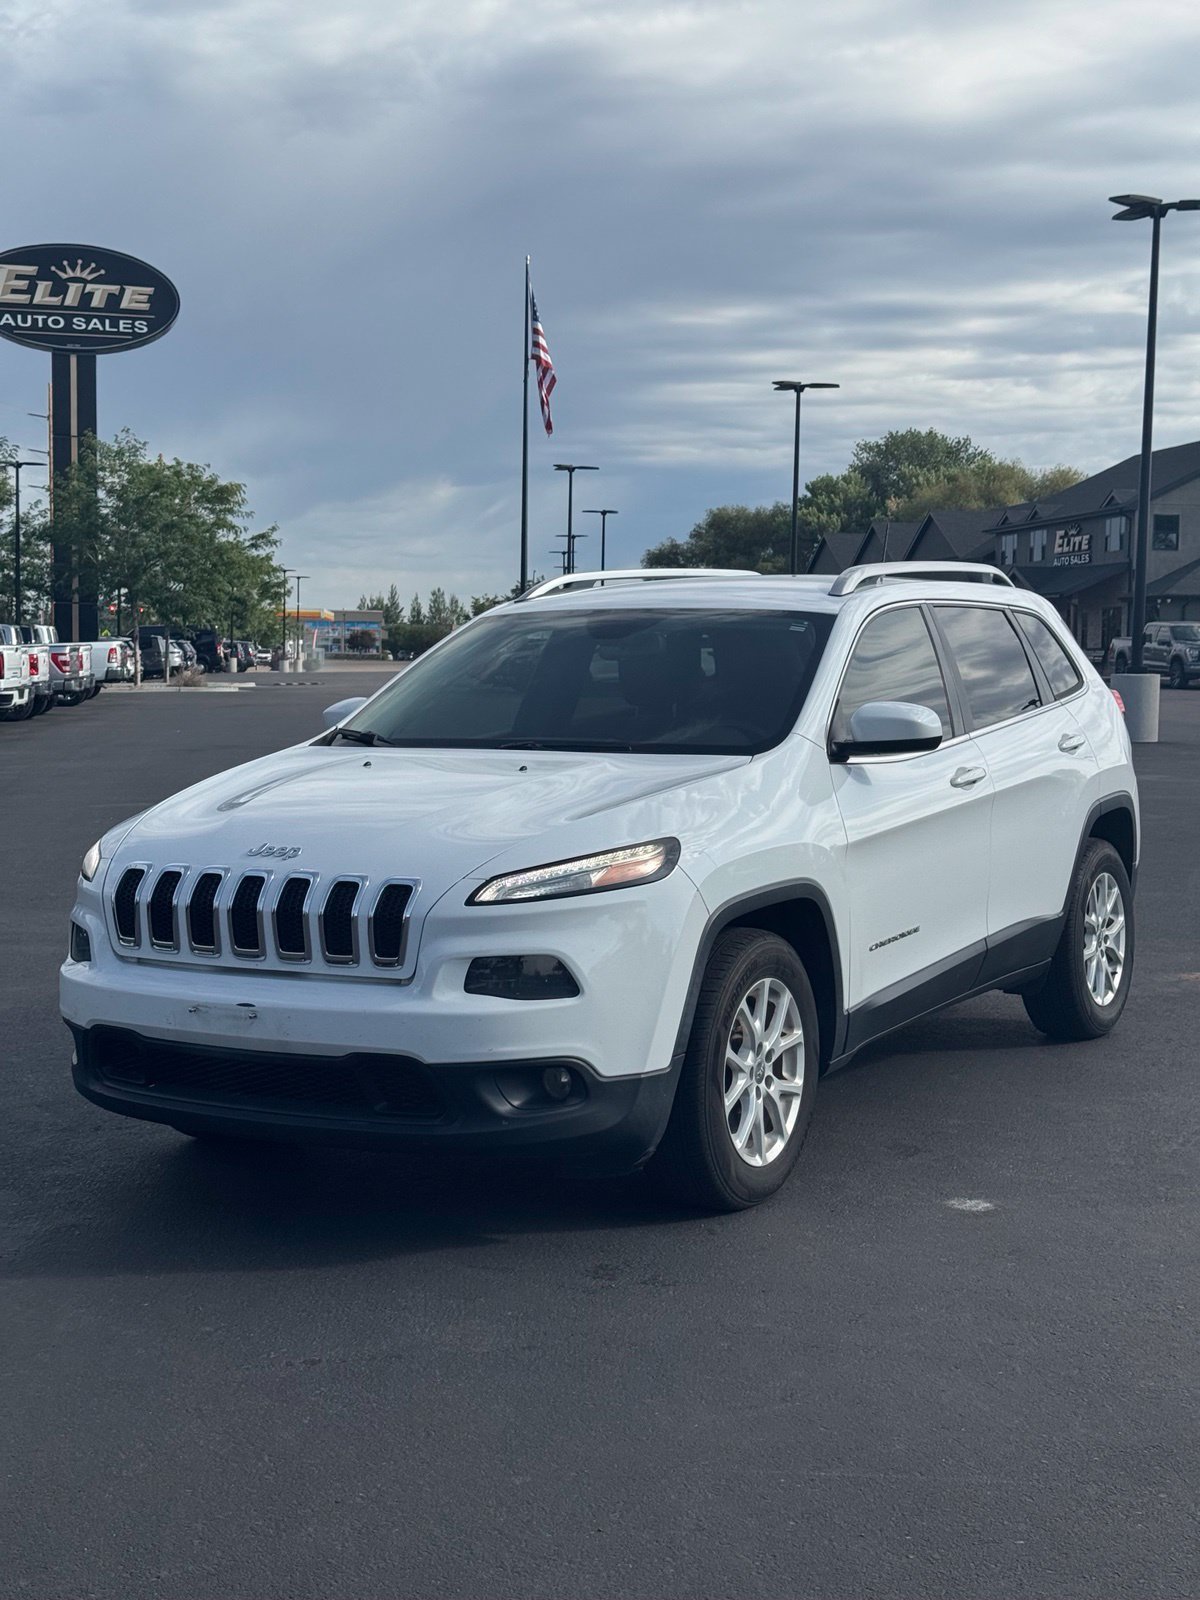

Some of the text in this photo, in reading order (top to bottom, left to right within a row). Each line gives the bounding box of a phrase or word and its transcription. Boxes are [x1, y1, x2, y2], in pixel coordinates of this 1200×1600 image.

[0, 264, 155, 311] ELITE
[0, 313, 149, 333] AUTO SALES
[1053, 530, 1090, 554] ELITE
[1053, 553, 1090, 567] AUTO SALES
[247, 842, 302, 861] Jeep
